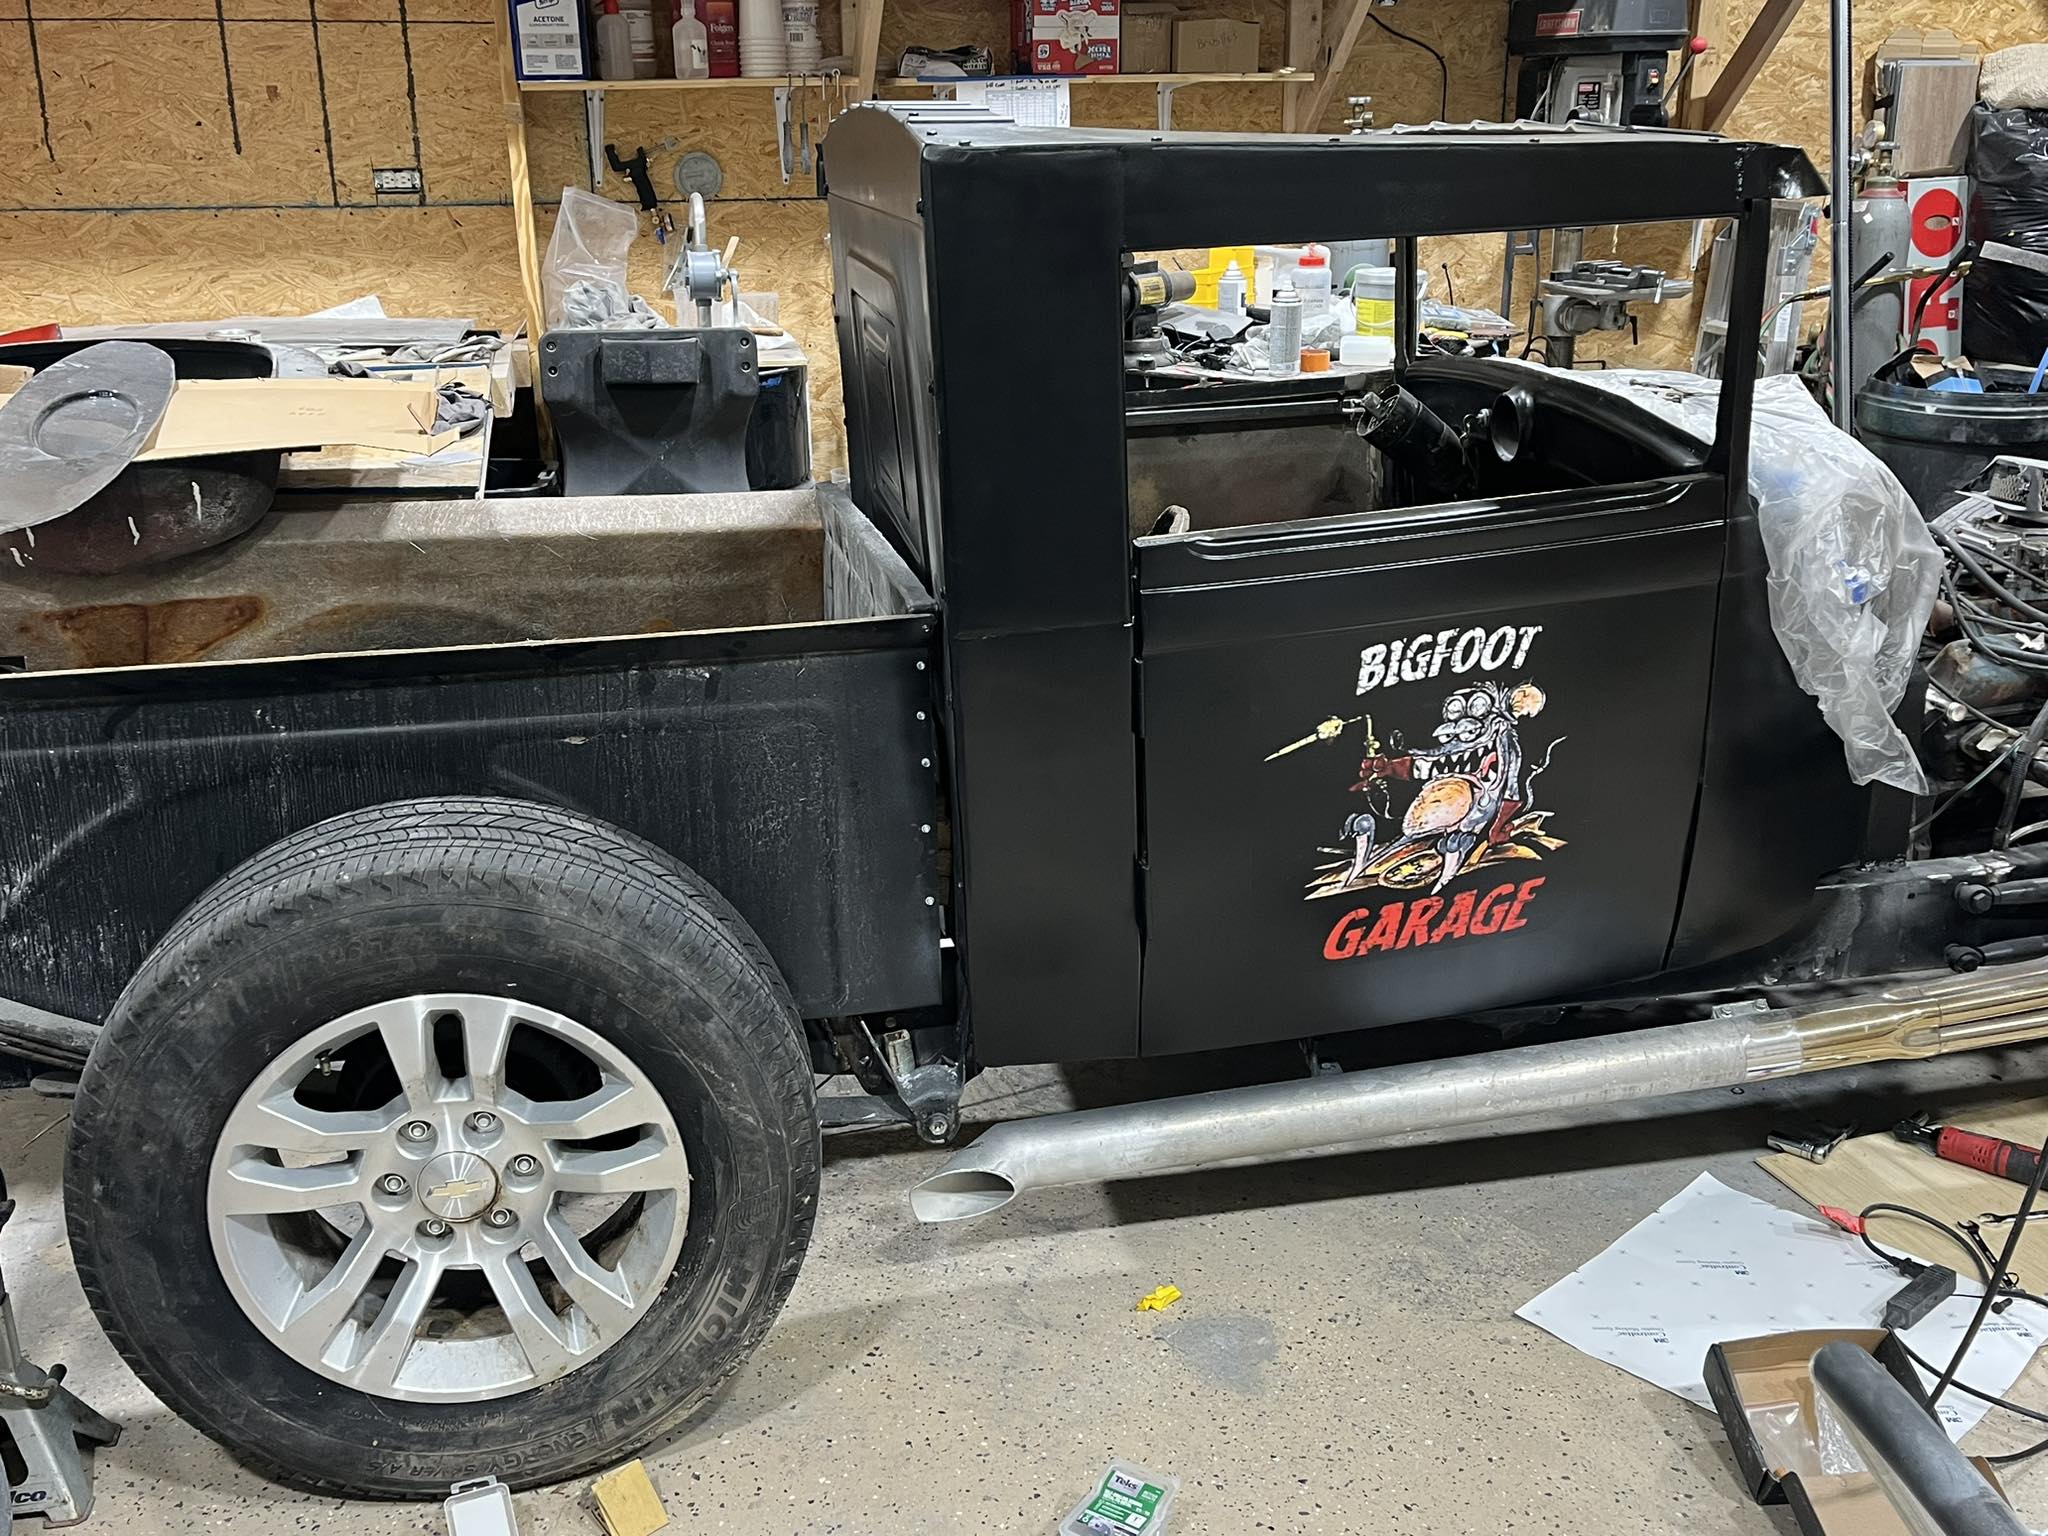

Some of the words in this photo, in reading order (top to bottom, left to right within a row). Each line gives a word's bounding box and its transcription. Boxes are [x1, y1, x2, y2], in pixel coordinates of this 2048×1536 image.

[1354, 625, 1544, 697] BIGFOOT
[1322, 876, 1546, 961] GARAGE
[1114, 1474, 1139, 1491] Teks
